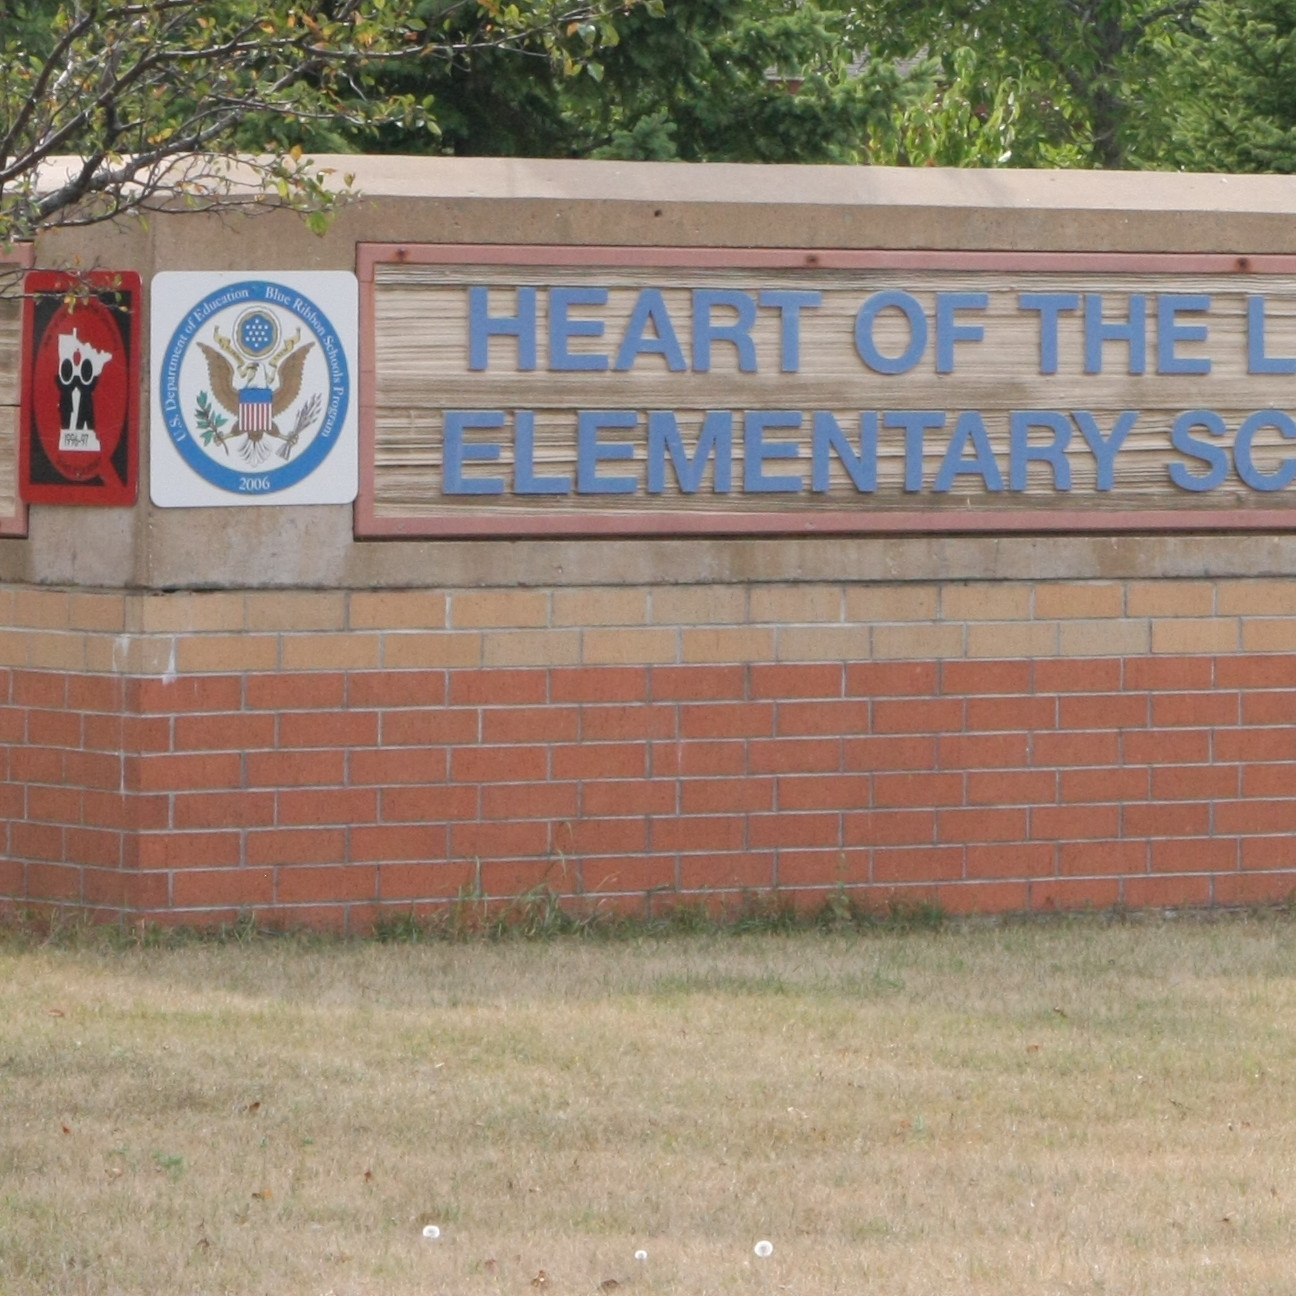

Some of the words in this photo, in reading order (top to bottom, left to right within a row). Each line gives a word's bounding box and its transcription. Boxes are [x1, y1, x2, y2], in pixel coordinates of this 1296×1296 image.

[194, 288, 249, 322] Education
[264, 286, 291, 305] Blue
[185, 318, 197, 333] of
[292, 297, 326, 337] Ribbon
[467, 286, 822, 373] HEART
[854, 290, 988, 374] OF
[1018, 292, 1212, 375] THE
[165, 334, 188, 411] Department
[322, 334, 341, 384] Schools
[170, 414, 186, 442] U.S.
[321, 385, 344, 438] Program
[443, 410, 1140, 495] ELEMENTARY
[238, 477, 270, 491] 2006
